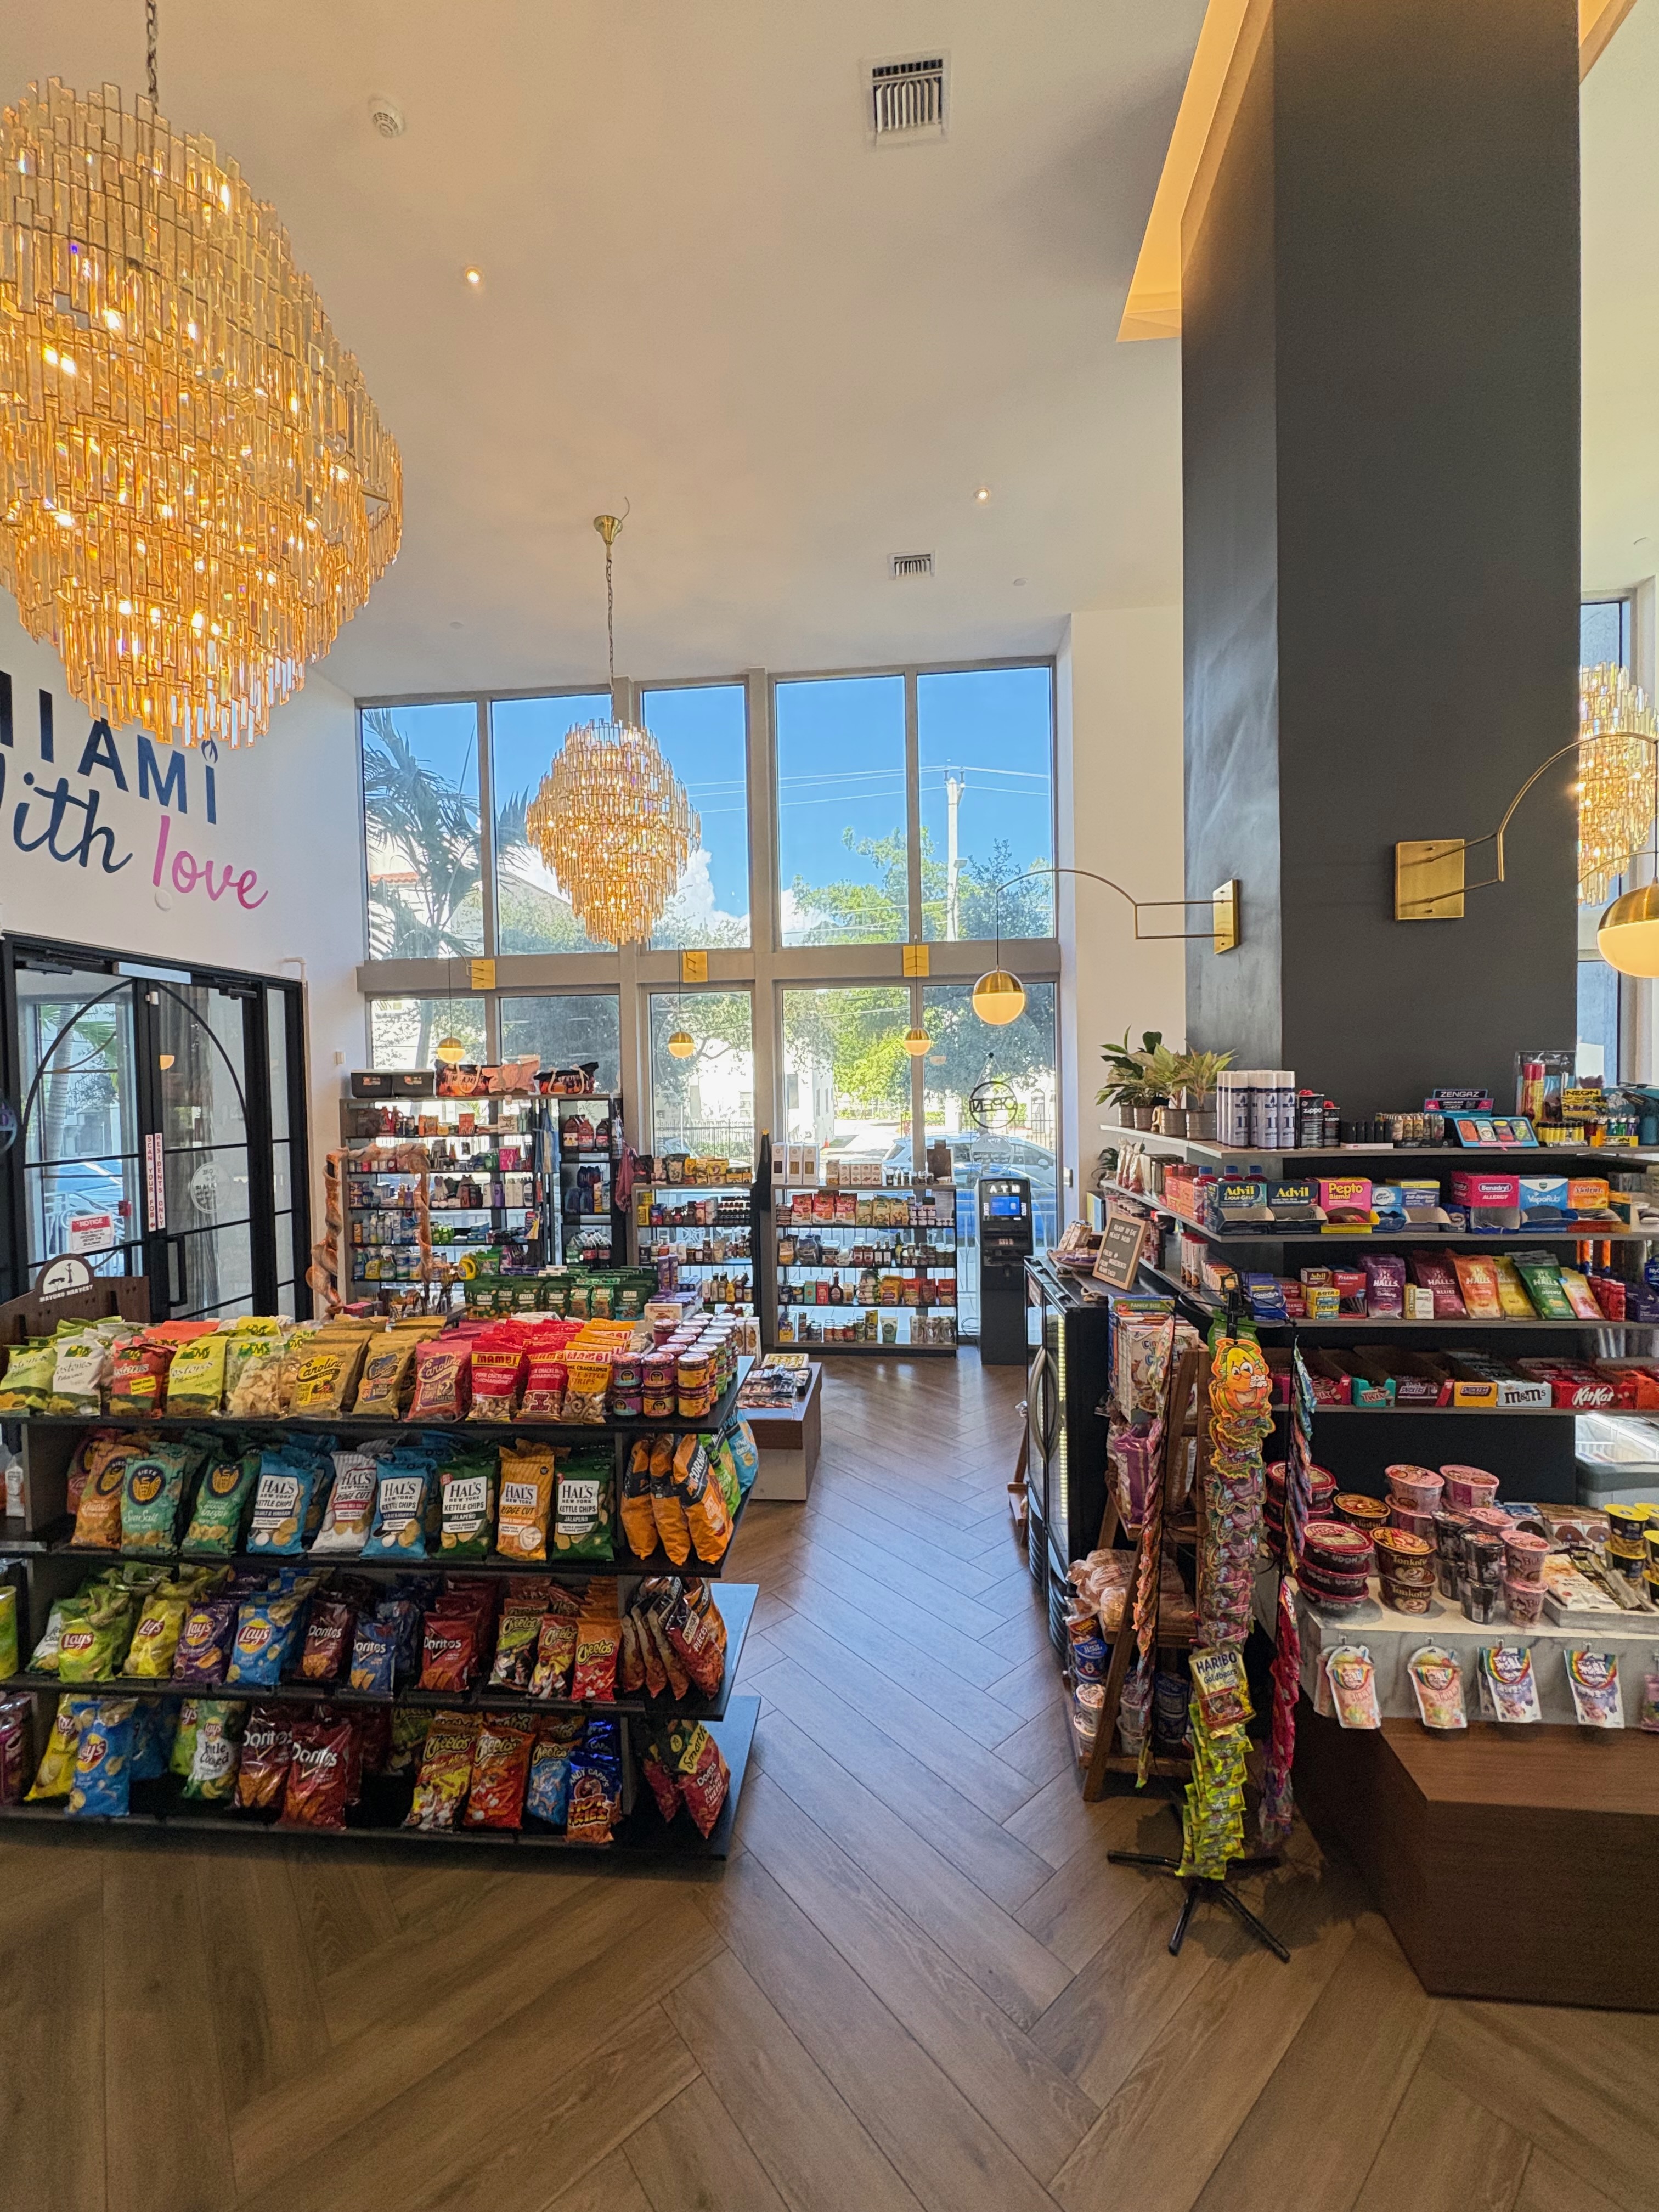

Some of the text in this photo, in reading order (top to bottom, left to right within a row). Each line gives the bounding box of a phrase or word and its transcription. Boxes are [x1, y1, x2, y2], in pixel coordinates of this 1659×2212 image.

[0, 753, 268, 910] ith love
[990, 1184, 1020, 1194] ATM
[1224, 1185, 1254, 1196] Advil
[1276, 1187, 1309, 1198] Advil
[1328, 1183, 1363, 1195] Pepto
[1527, 1194, 1560, 1204] VapoRub
[78, 1217, 103, 1228] NOTICE
[567, 1352, 609, 1362] MAMBI
[297, 1357, 345, 1383] Carolina
[419, 1356, 462, 1383] Carolina
[138, 1468, 157, 1477] SIETE
[356, 1491, 370, 1499] CUT
[450, 1481, 482, 1498] HAL'S
[506, 1484, 534, 1500] HAL'S
[562, 1484, 594, 1499] HAL'S
[467, 1501, 484, 1509] CHIPS
[500, 1506, 535, 1515] RIDGE CUT
[450, 1512, 476, 1521] JALAPEÑO
[1332, 1554, 1358, 1564] UDON
[308, 1624, 342, 1639] Doritos
[502, 1616, 538, 1635] Cheetos
[238, 1626, 270, 1645] Lay's
[424, 1636, 461, 1650] Doritos
[544, 1626, 578, 1646] Cheetos
[693, 1626, 708, 1652] PIECES
[577, 1640, 614, 1665] Cheetos
[1196, 1651, 1238, 1675] HARIBO
[1203, 1667, 1238, 1684] Goldbears
[292, 1742, 338, 1768] Doritos
[424, 1734, 472, 1761] Cheetos
[475, 1733, 517, 1765] Cheetos
[532, 1744, 568, 1765] Cheetos
[570, 1799, 605, 1812] HOT
